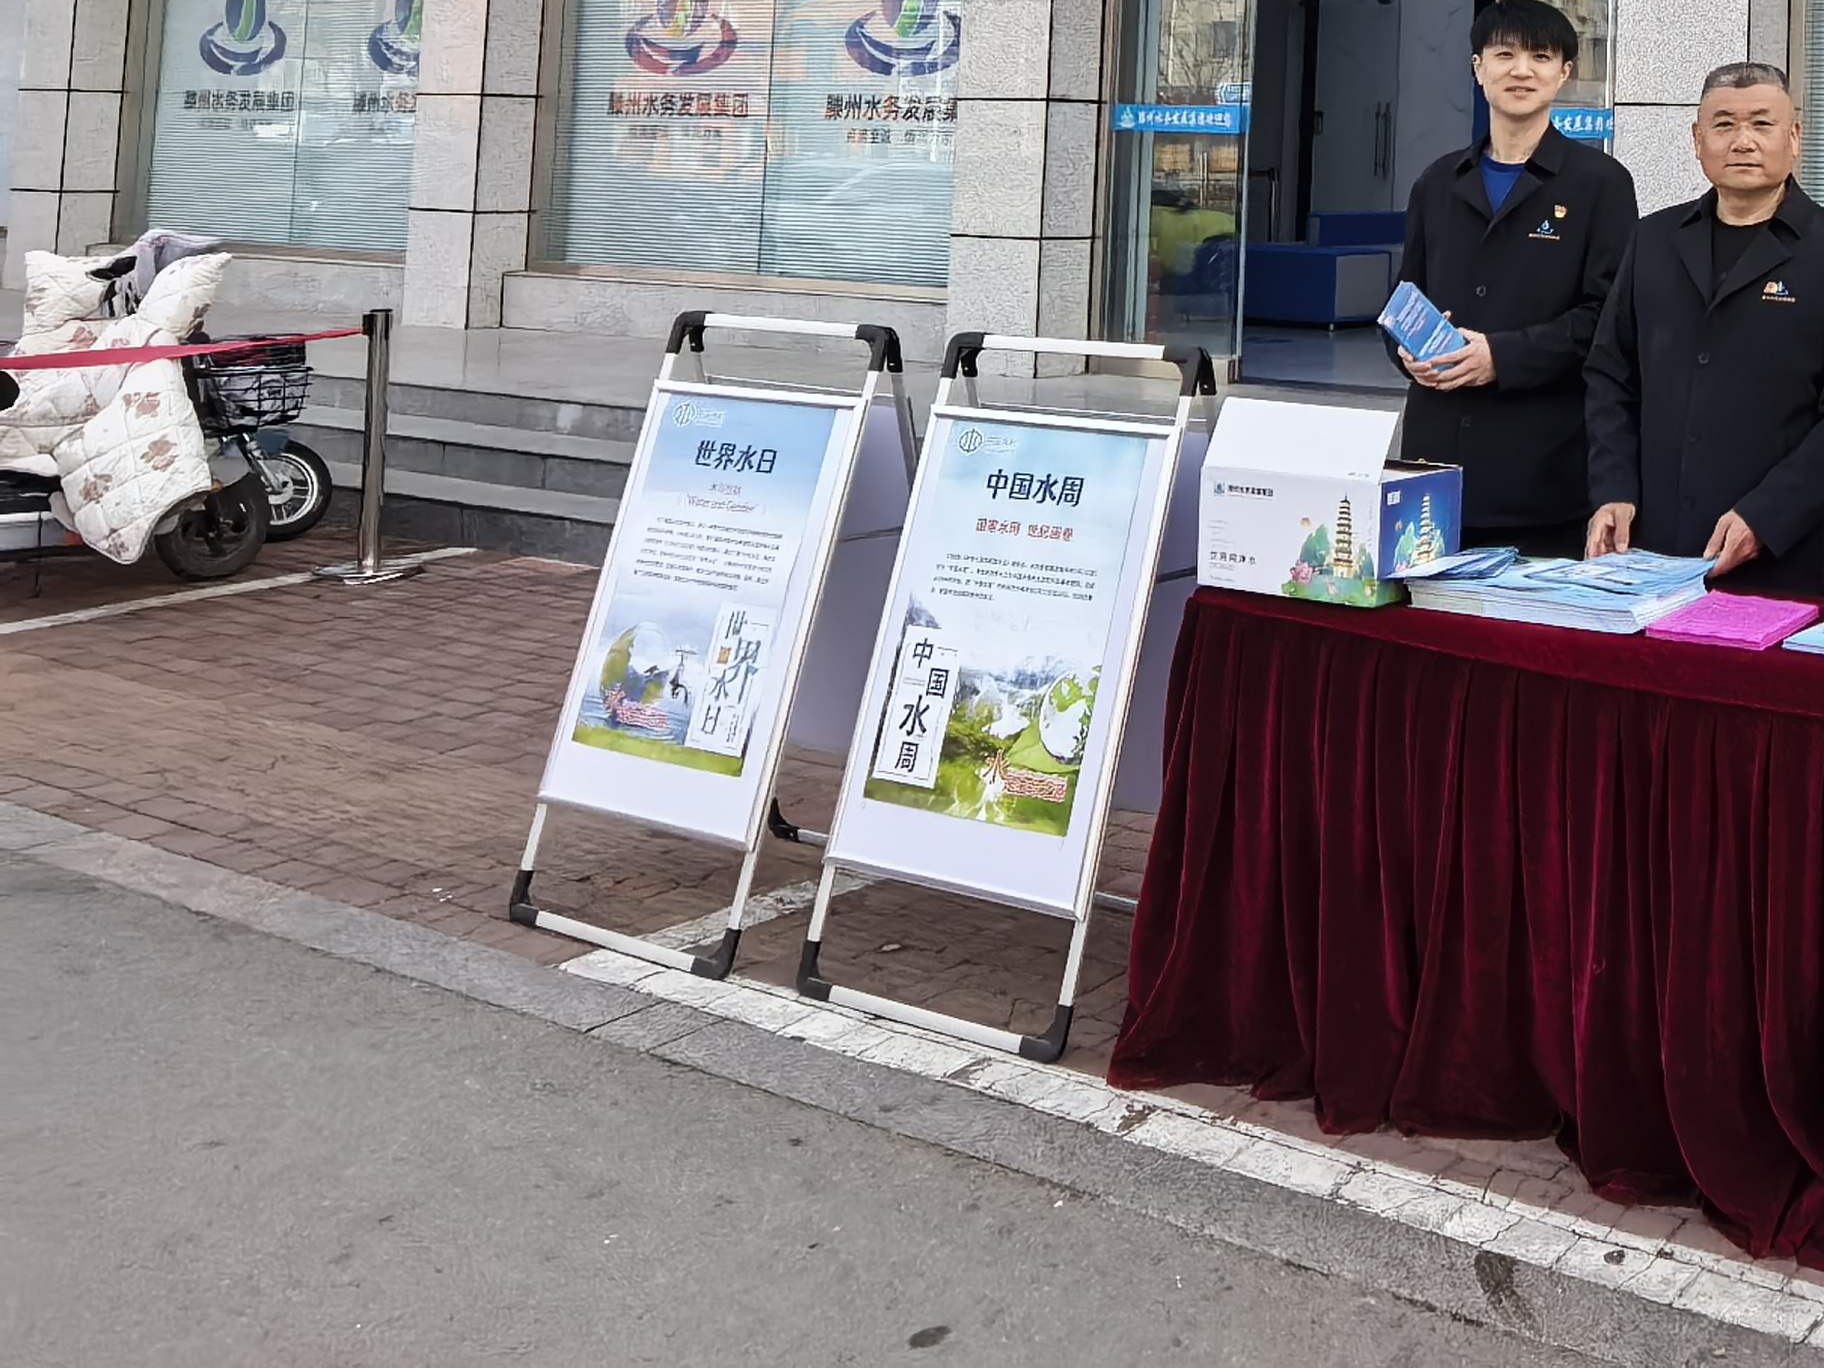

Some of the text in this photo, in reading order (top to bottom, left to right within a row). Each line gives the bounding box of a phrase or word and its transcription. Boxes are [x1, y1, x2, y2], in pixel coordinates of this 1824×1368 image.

[607, 91, 749, 118] 滕州水务发展集团
[695, 439, 777, 474] 世界水日
[986, 469, 1085, 508] 中国水周
[894, 637, 949, 773] 中国水周
